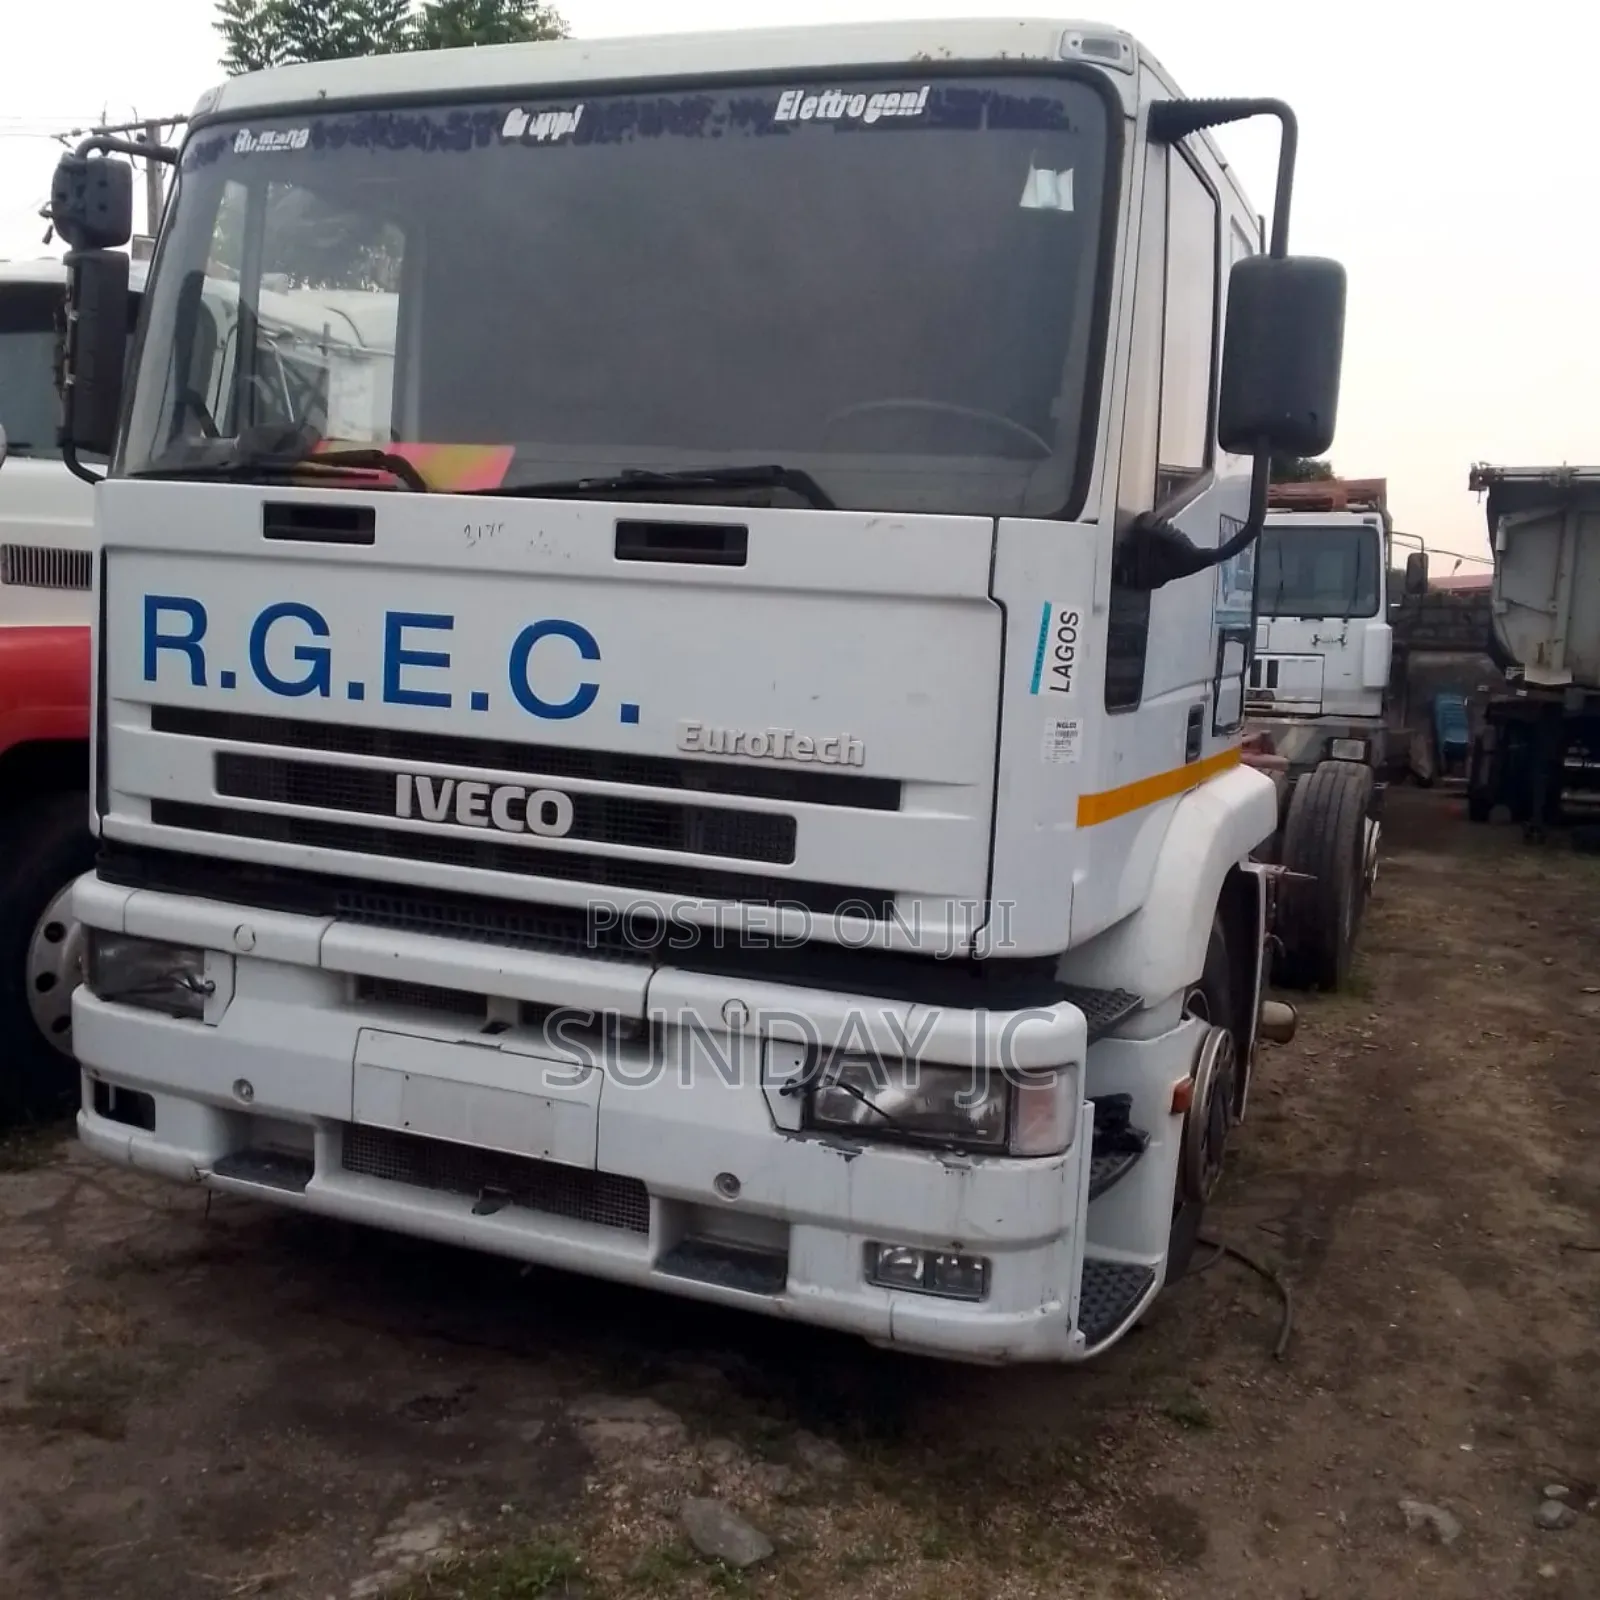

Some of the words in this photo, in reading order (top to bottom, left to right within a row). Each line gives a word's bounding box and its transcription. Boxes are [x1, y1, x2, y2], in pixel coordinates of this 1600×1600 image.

[1049, 611, 1079, 693] LAGOS
[677, 718, 865, 767] EuroTech
[395, 774, 574, 837] IVECO
